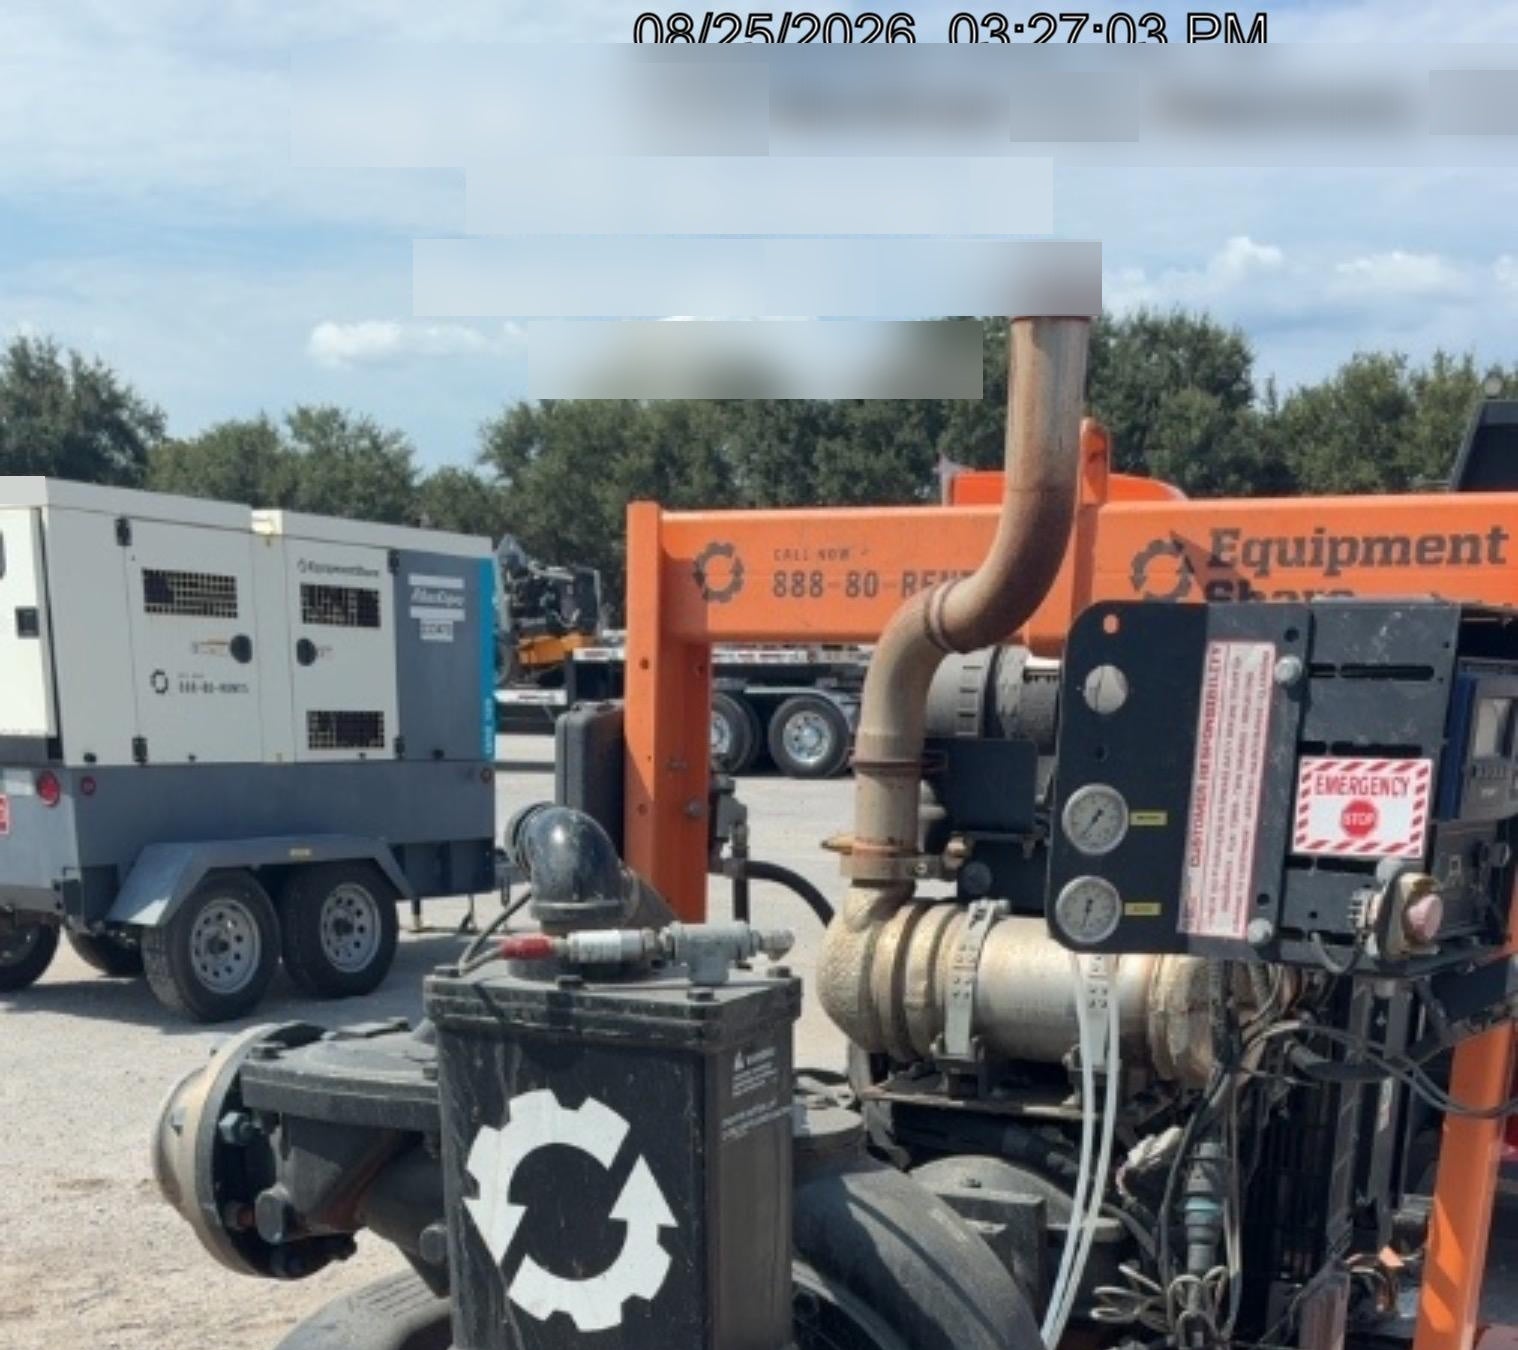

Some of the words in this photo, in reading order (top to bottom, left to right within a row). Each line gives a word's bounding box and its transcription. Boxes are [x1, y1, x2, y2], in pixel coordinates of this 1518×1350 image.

[774, 549, 808, 561] CALL
[819, 549, 849, 561] NOW
[1207, 526, 1510, 577] Equipment
[773, 570, 976, 598] 888-80-RE
[1315, 774, 1410, 797] EMERGENCY
[1343, 811, 1375, 827] STOP
